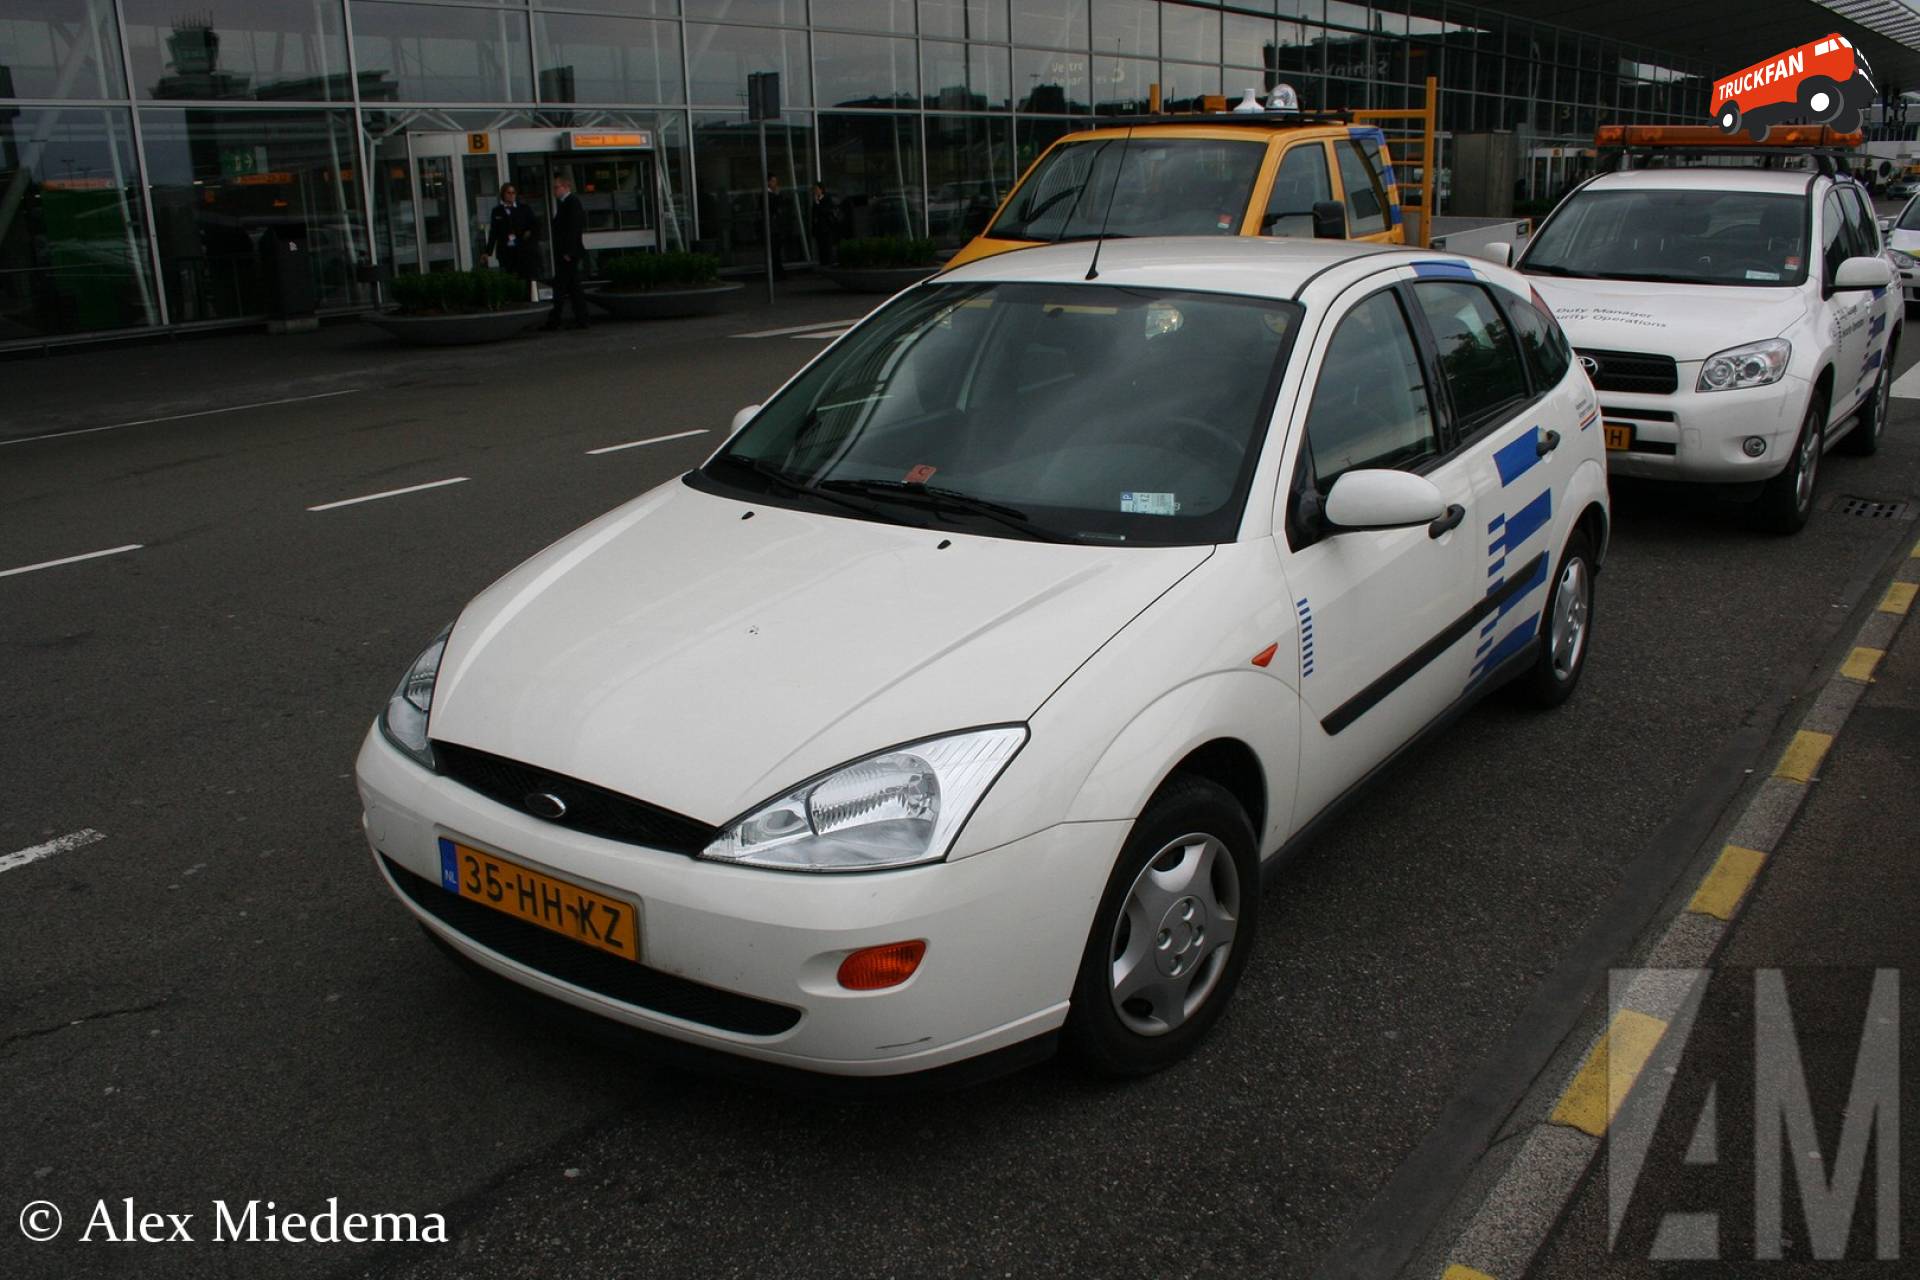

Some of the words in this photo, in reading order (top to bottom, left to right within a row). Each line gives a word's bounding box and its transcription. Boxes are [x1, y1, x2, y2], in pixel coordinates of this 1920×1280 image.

[473, 134, 484, 149] B
[1593, 308, 1653, 319] Manager
[1593, 315, 1667, 328] Operations
[444, 869, 457, 884] NL
[464, 855, 624, 949] 35-HH-KZ
